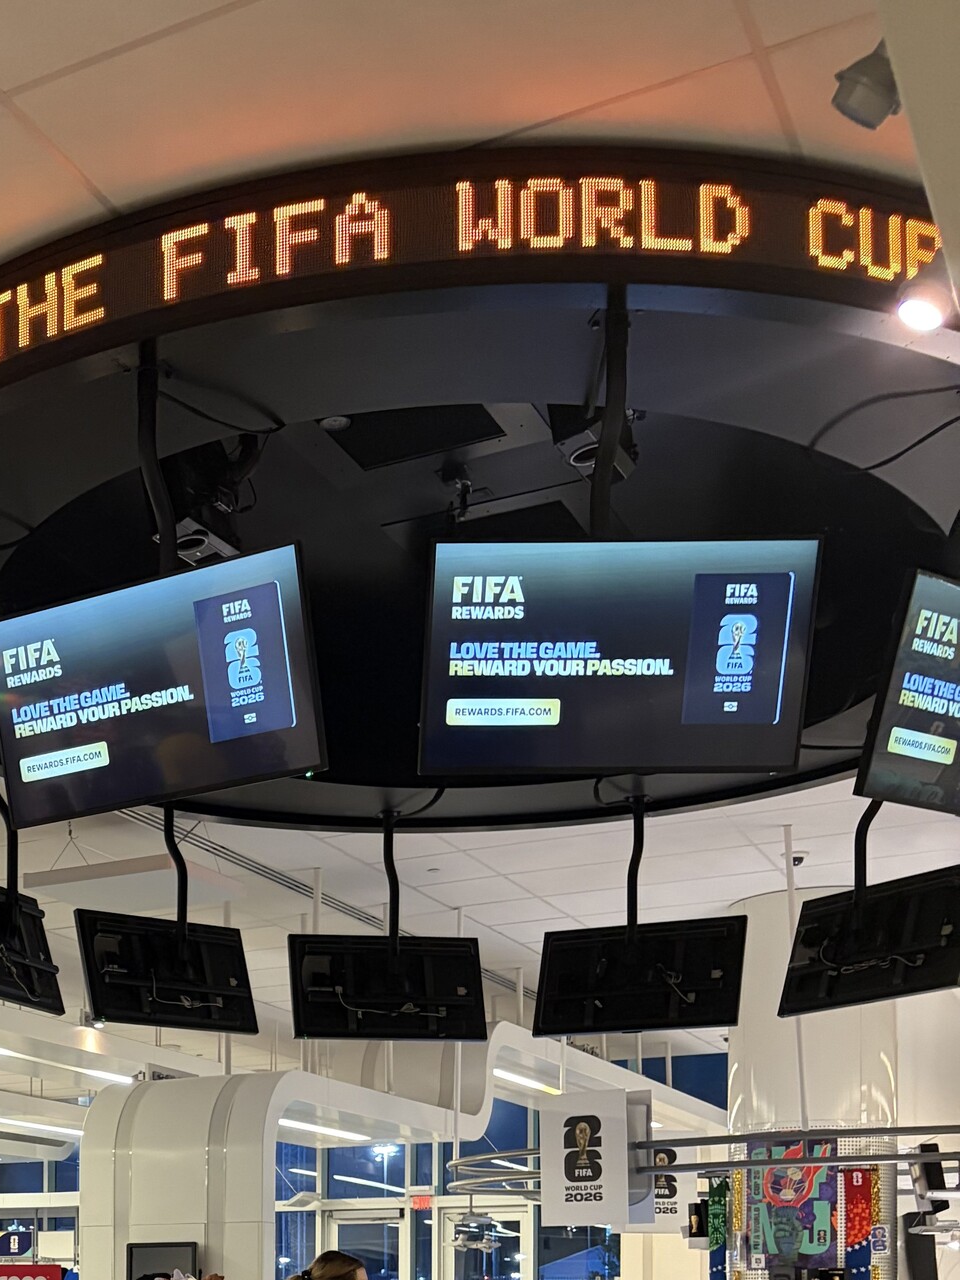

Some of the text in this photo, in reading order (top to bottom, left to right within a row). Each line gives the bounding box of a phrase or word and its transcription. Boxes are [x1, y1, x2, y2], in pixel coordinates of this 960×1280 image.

[161, 192, 391, 301] FIFA
[456, 177, 751, 254] WORLD
[808, 197, 943, 282] CUP
[451, 575, 525, 603] FIFA
[726, 583, 759, 597] FIFA
[222, 599, 251, 616] FIFA
[451, 605, 525, 620] REWARDS
[915, 608, 959, 644] FIFA
[2, 639, 60, 674] FIFA
[449, 641, 601, 659] LOVE THE GAME.
[911, 637, 956, 660] REWARDS
[448, 658, 674, 676] REWARD YOUR PASSION.
[726, 661, 743, 669] FIFA
[6, 664, 63, 688] REWARDS
[238, 674, 253, 684] FIFA
[713, 682, 752, 692] 2026
[902, 671, 935, 694] LOVE
[934, 679, 957, 700] THE
[11, 683, 130, 724] LOVE THE GAME.
[231, 692, 265, 707] 2026
[898, 689, 949, 715] REWARD
[14, 685, 195, 739] REWARD YOUR PASSION.
[454, 707, 552, 716] REWARDS.FIFA.COM
[26, 751, 103, 774] REWARDS.FIFA.COM
[575, 1168, 593, 1177] FIFA
[564, 1192, 603, 1202] 2026
[654, 1206, 678, 1214] 026
